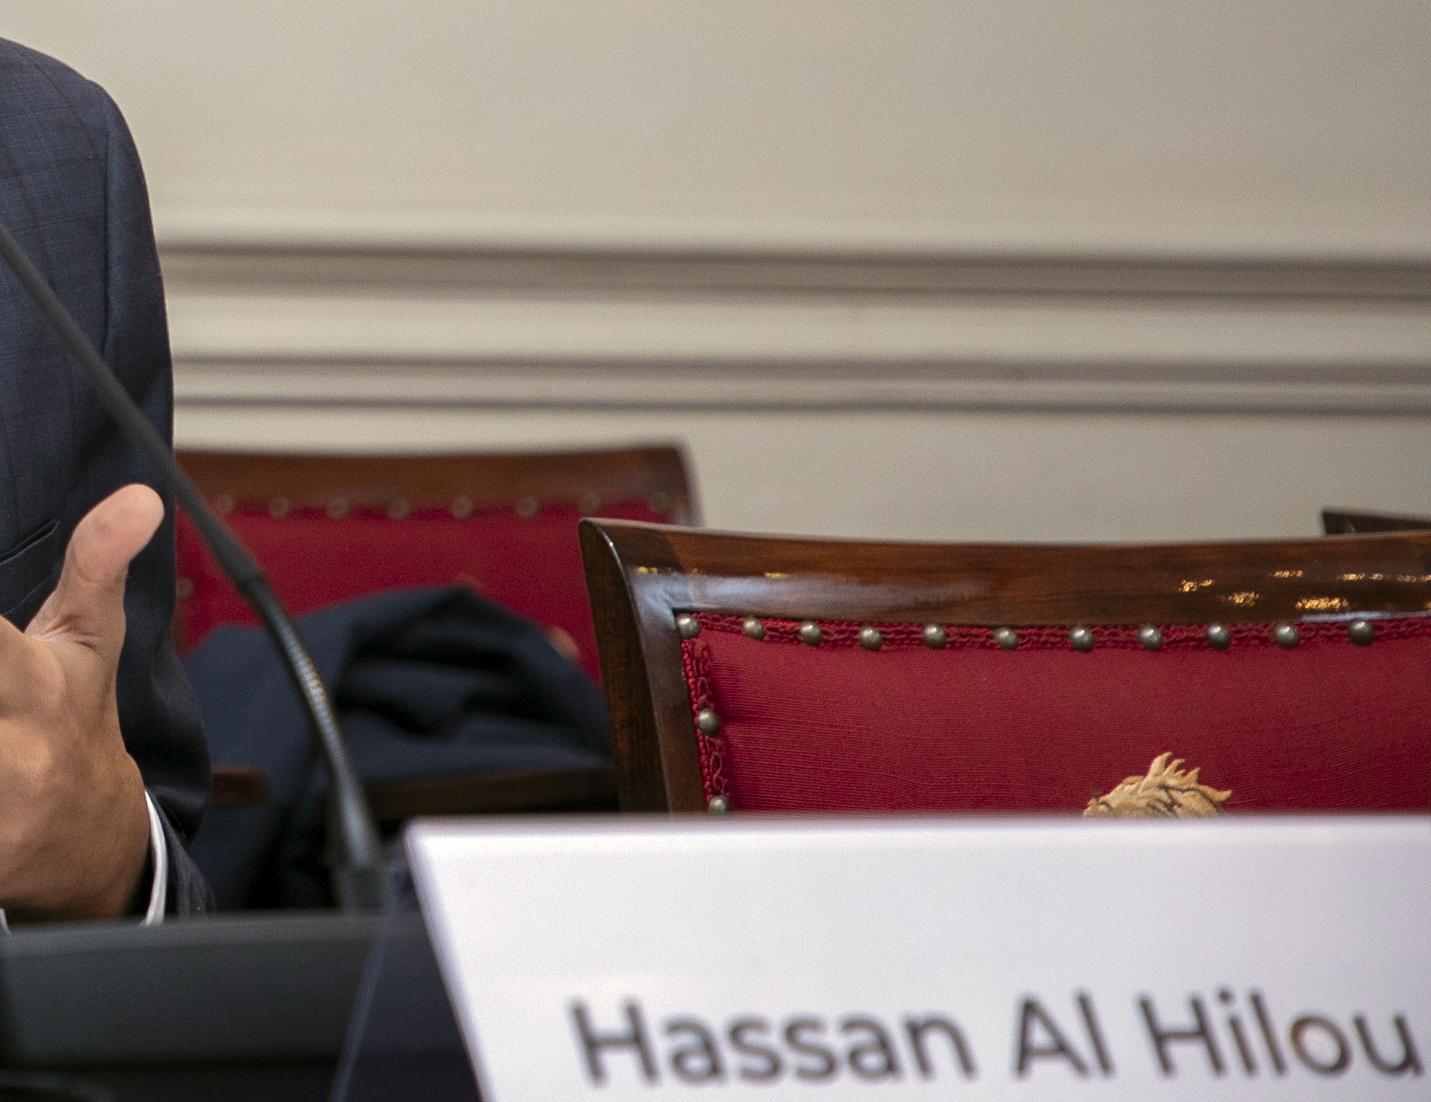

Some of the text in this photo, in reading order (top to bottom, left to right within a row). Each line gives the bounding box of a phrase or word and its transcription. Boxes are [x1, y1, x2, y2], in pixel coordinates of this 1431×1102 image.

[570, 987, 1428, 1084] Hassan Al Hilou
